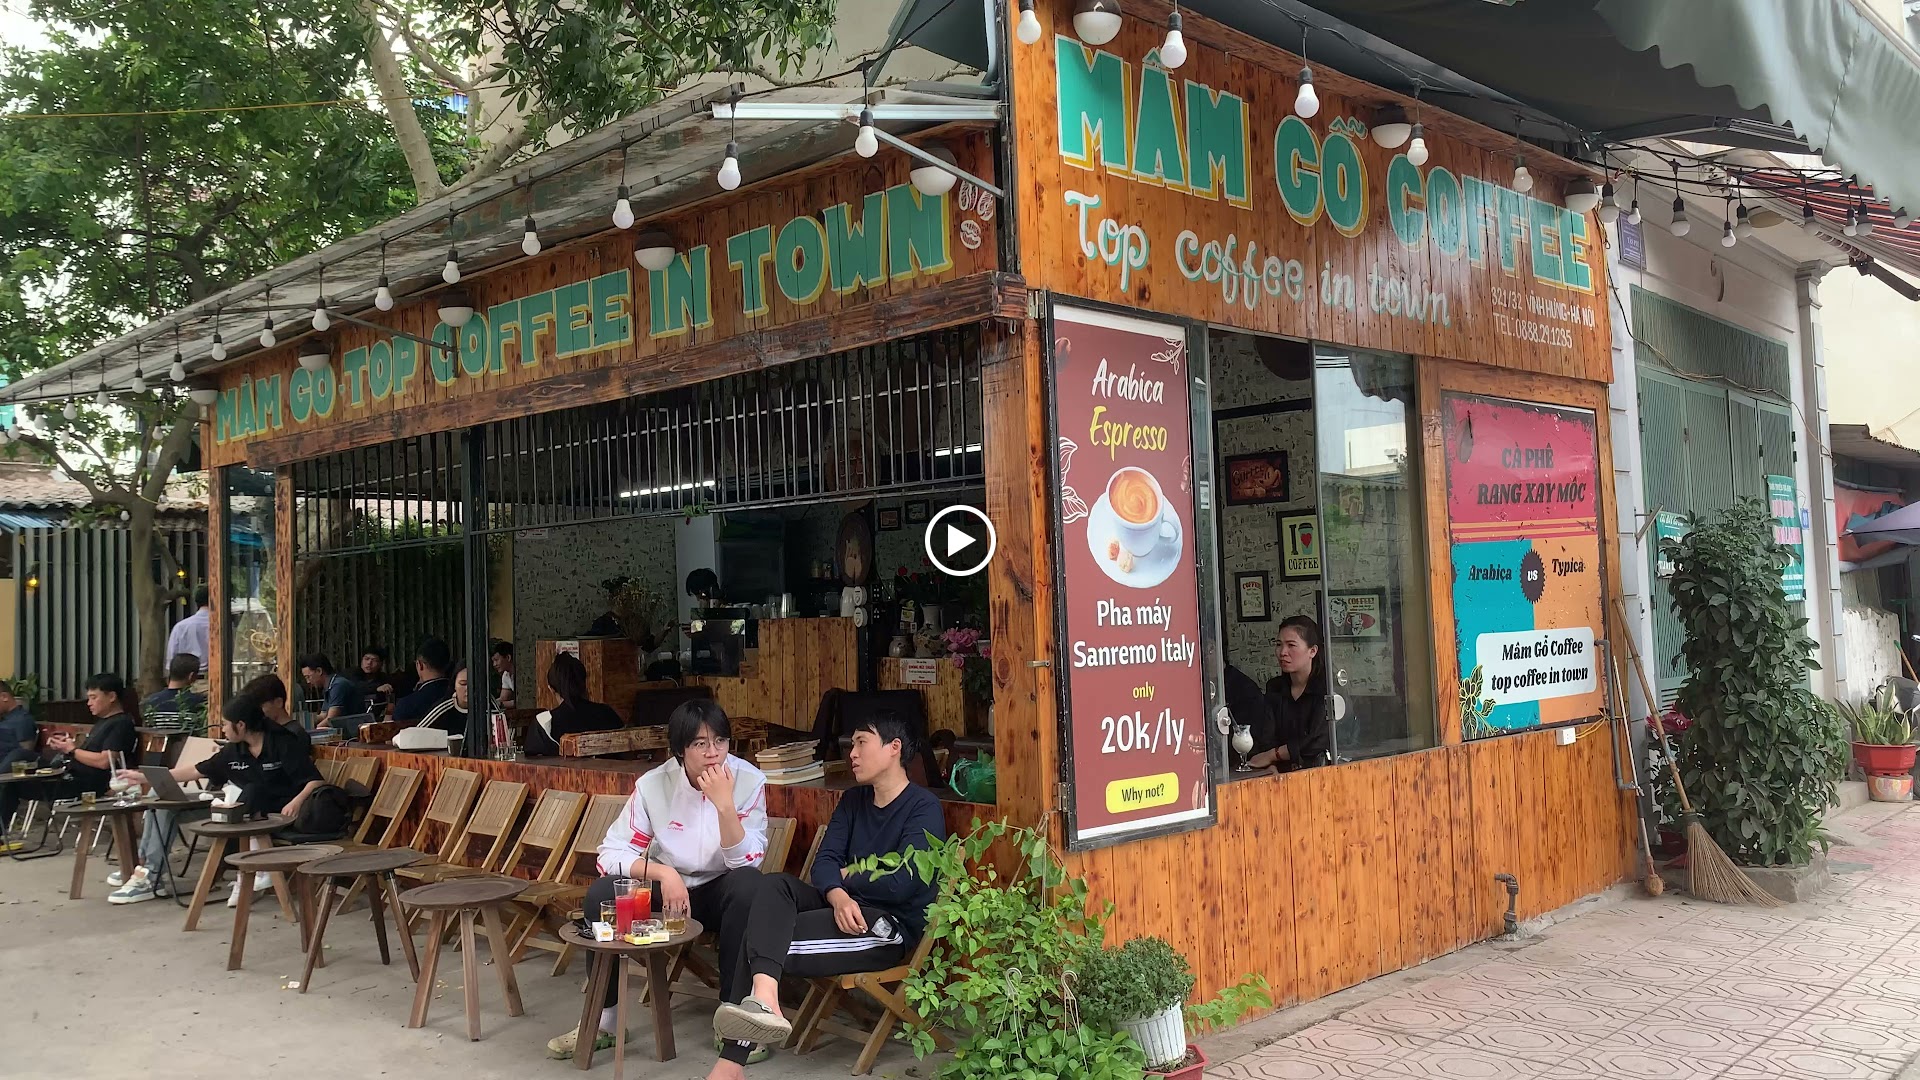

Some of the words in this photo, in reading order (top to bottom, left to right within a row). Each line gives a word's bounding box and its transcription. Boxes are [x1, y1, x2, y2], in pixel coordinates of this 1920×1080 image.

[1055, 34, 1253, 211] MÂM
[1274, 115, 1369, 238] GỖ
[1387, 153, 1595, 296] COFFEE
[1064, 190, 1151, 292] Top
[1175, 229, 1304, 311] coffee
[1320, 261, 1355, 310] in
[1368, 261, 1452, 328] town
[216, 373, 284, 445] MÂM
[343, 332, 418, 409] TOP
[430, 268, 633, 387] COFFEE
[649, 244, 714, 339] IN
[726, 183, 953, 318] TOWN
[1491, 286, 1522, 310] 321/32
[1091, 357, 1165, 405] Arabica
[1089, 405, 1168, 461] Espresso
[1502, 441, 1522, 468] CÀ
[1525, 442, 1554, 469] PHÊ
[1477, 483, 1522, 505] RANG
[1523, 483, 1556, 504] XAY
[1557, 476, 1587, 510] MỘC
[1288, 523, 1299, 555] I
[1288, 557, 1319, 570] COFFEE
[1468, 563, 1512, 583] Arabica
[1552, 557, 1585, 577] Typica
[1096, 598, 1133, 627] Pha
[1136, 597, 1172, 631] máy
[1073, 640, 1157, 668] Sanremo
[1160, 634, 1195, 667] Italy
[1502, 642, 1532, 660] Mâm
[1534, 634, 1548, 658] Gỗ
[1550, 637, 1583, 656] Coffee
[1132, 681, 1155, 701] only
[1491, 674, 1512, 693] top
[1514, 668, 1547, 688] coffee
[1549, 666, 1560, 684] in
[1562, 667, 1588, 682] town
[1101, 707, 1185, 755] 20k/ly
[1121, 786, 1143, 804] Why
[1145, 783, 1165, 799] not?
